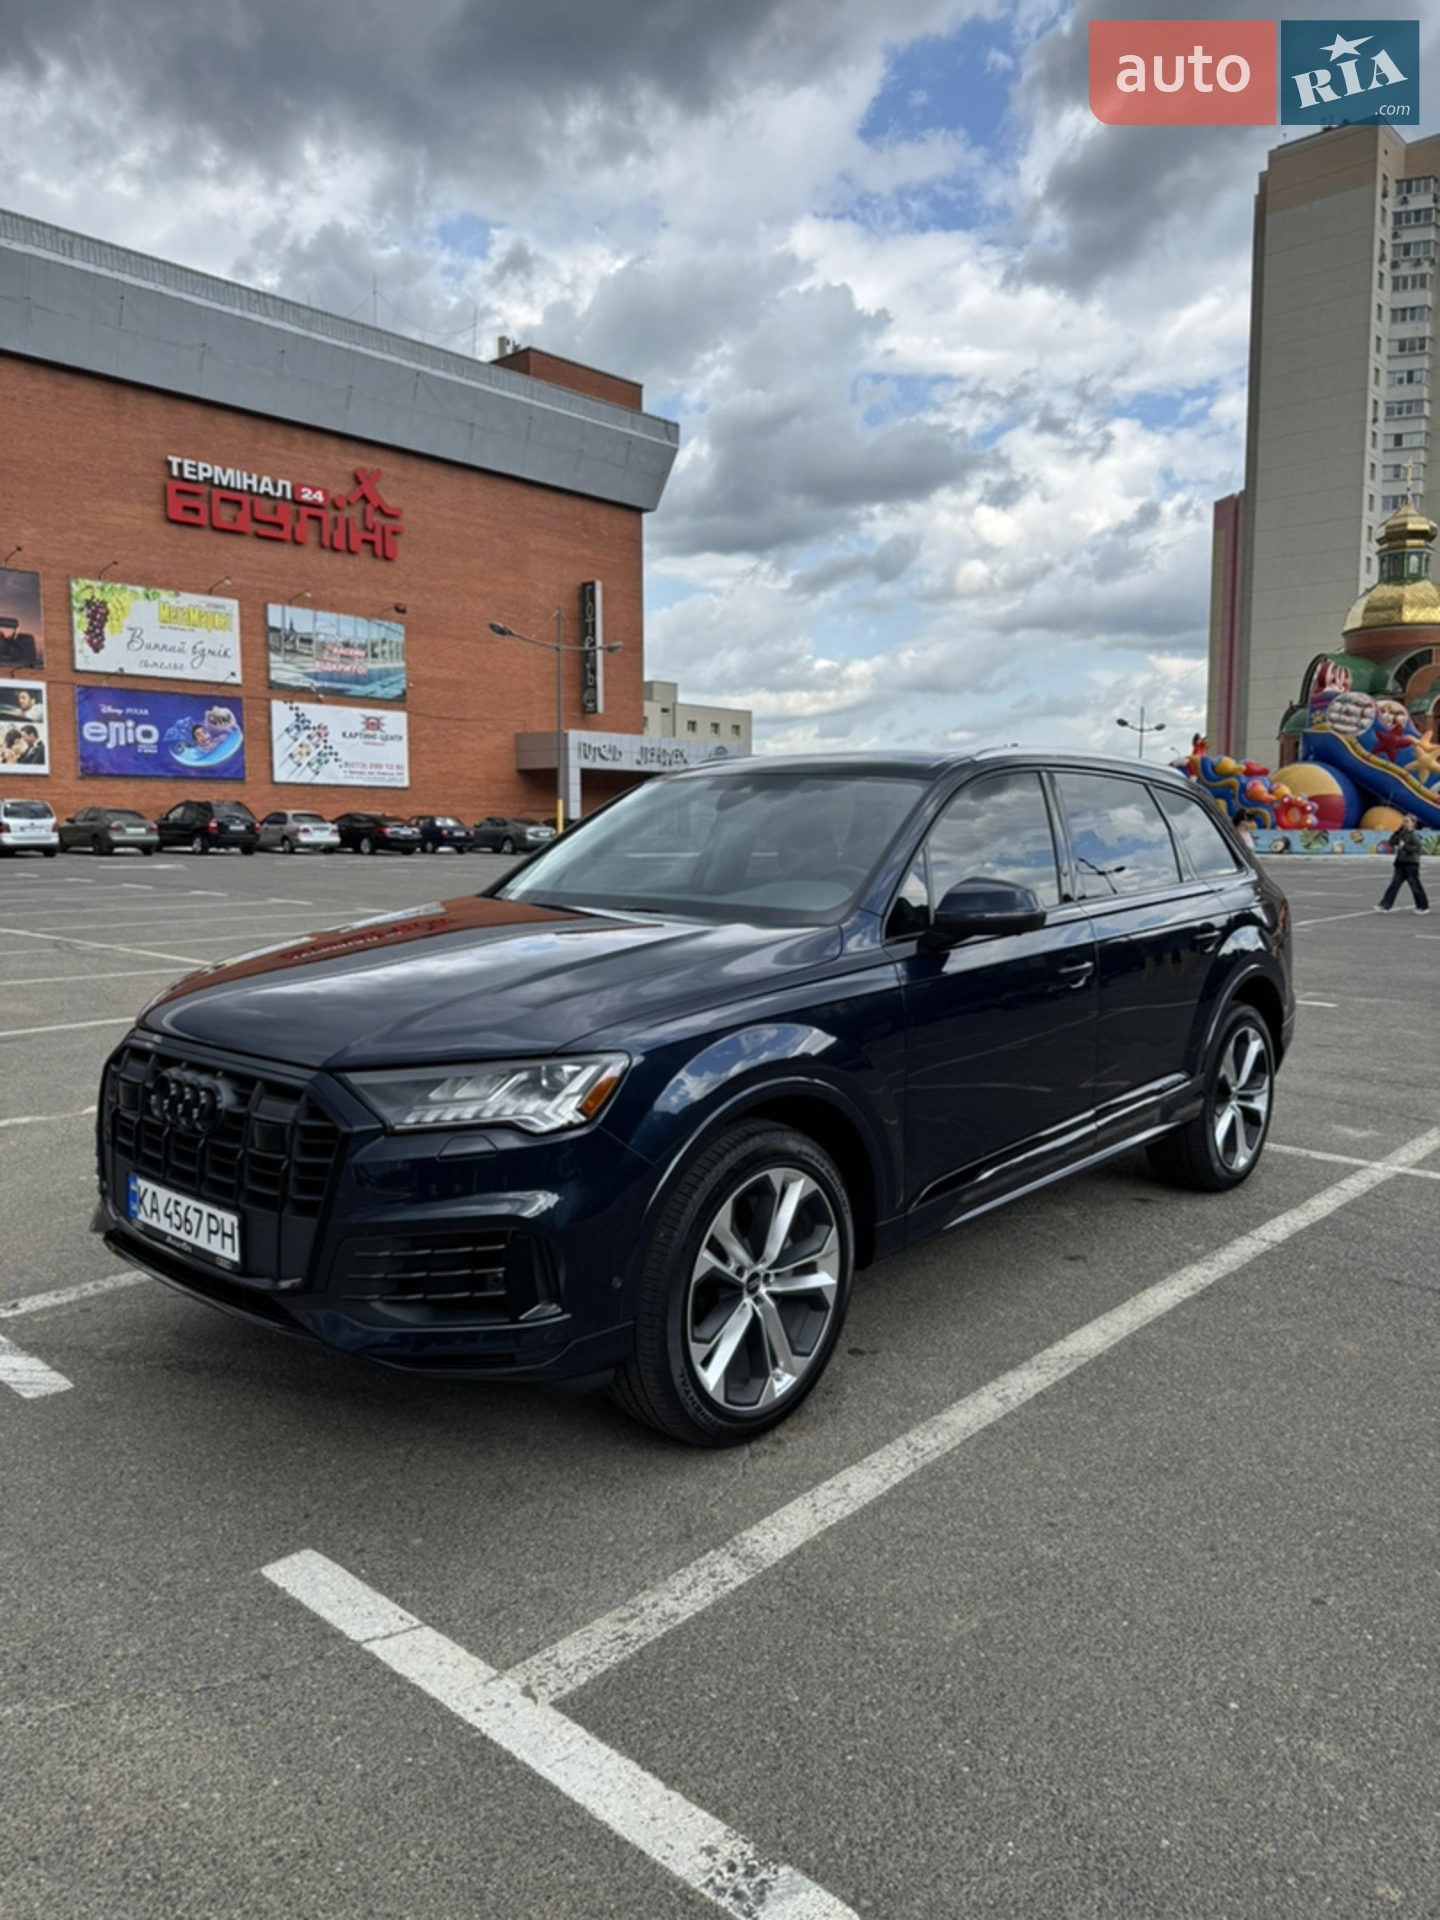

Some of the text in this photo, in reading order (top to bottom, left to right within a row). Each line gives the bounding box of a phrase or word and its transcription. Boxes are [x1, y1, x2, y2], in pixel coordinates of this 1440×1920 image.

[167, 455, 325, 503] ТЕРМІНАЛ 24
[166, 480, 403, 561] БОУЛІНГ
[125, 707, 149, 716] PIXAR
[138, 1185, 161, 1223] KA
[163, 1197, 204, 1239] 4567
[207, 1212, 235, 1254] PH
